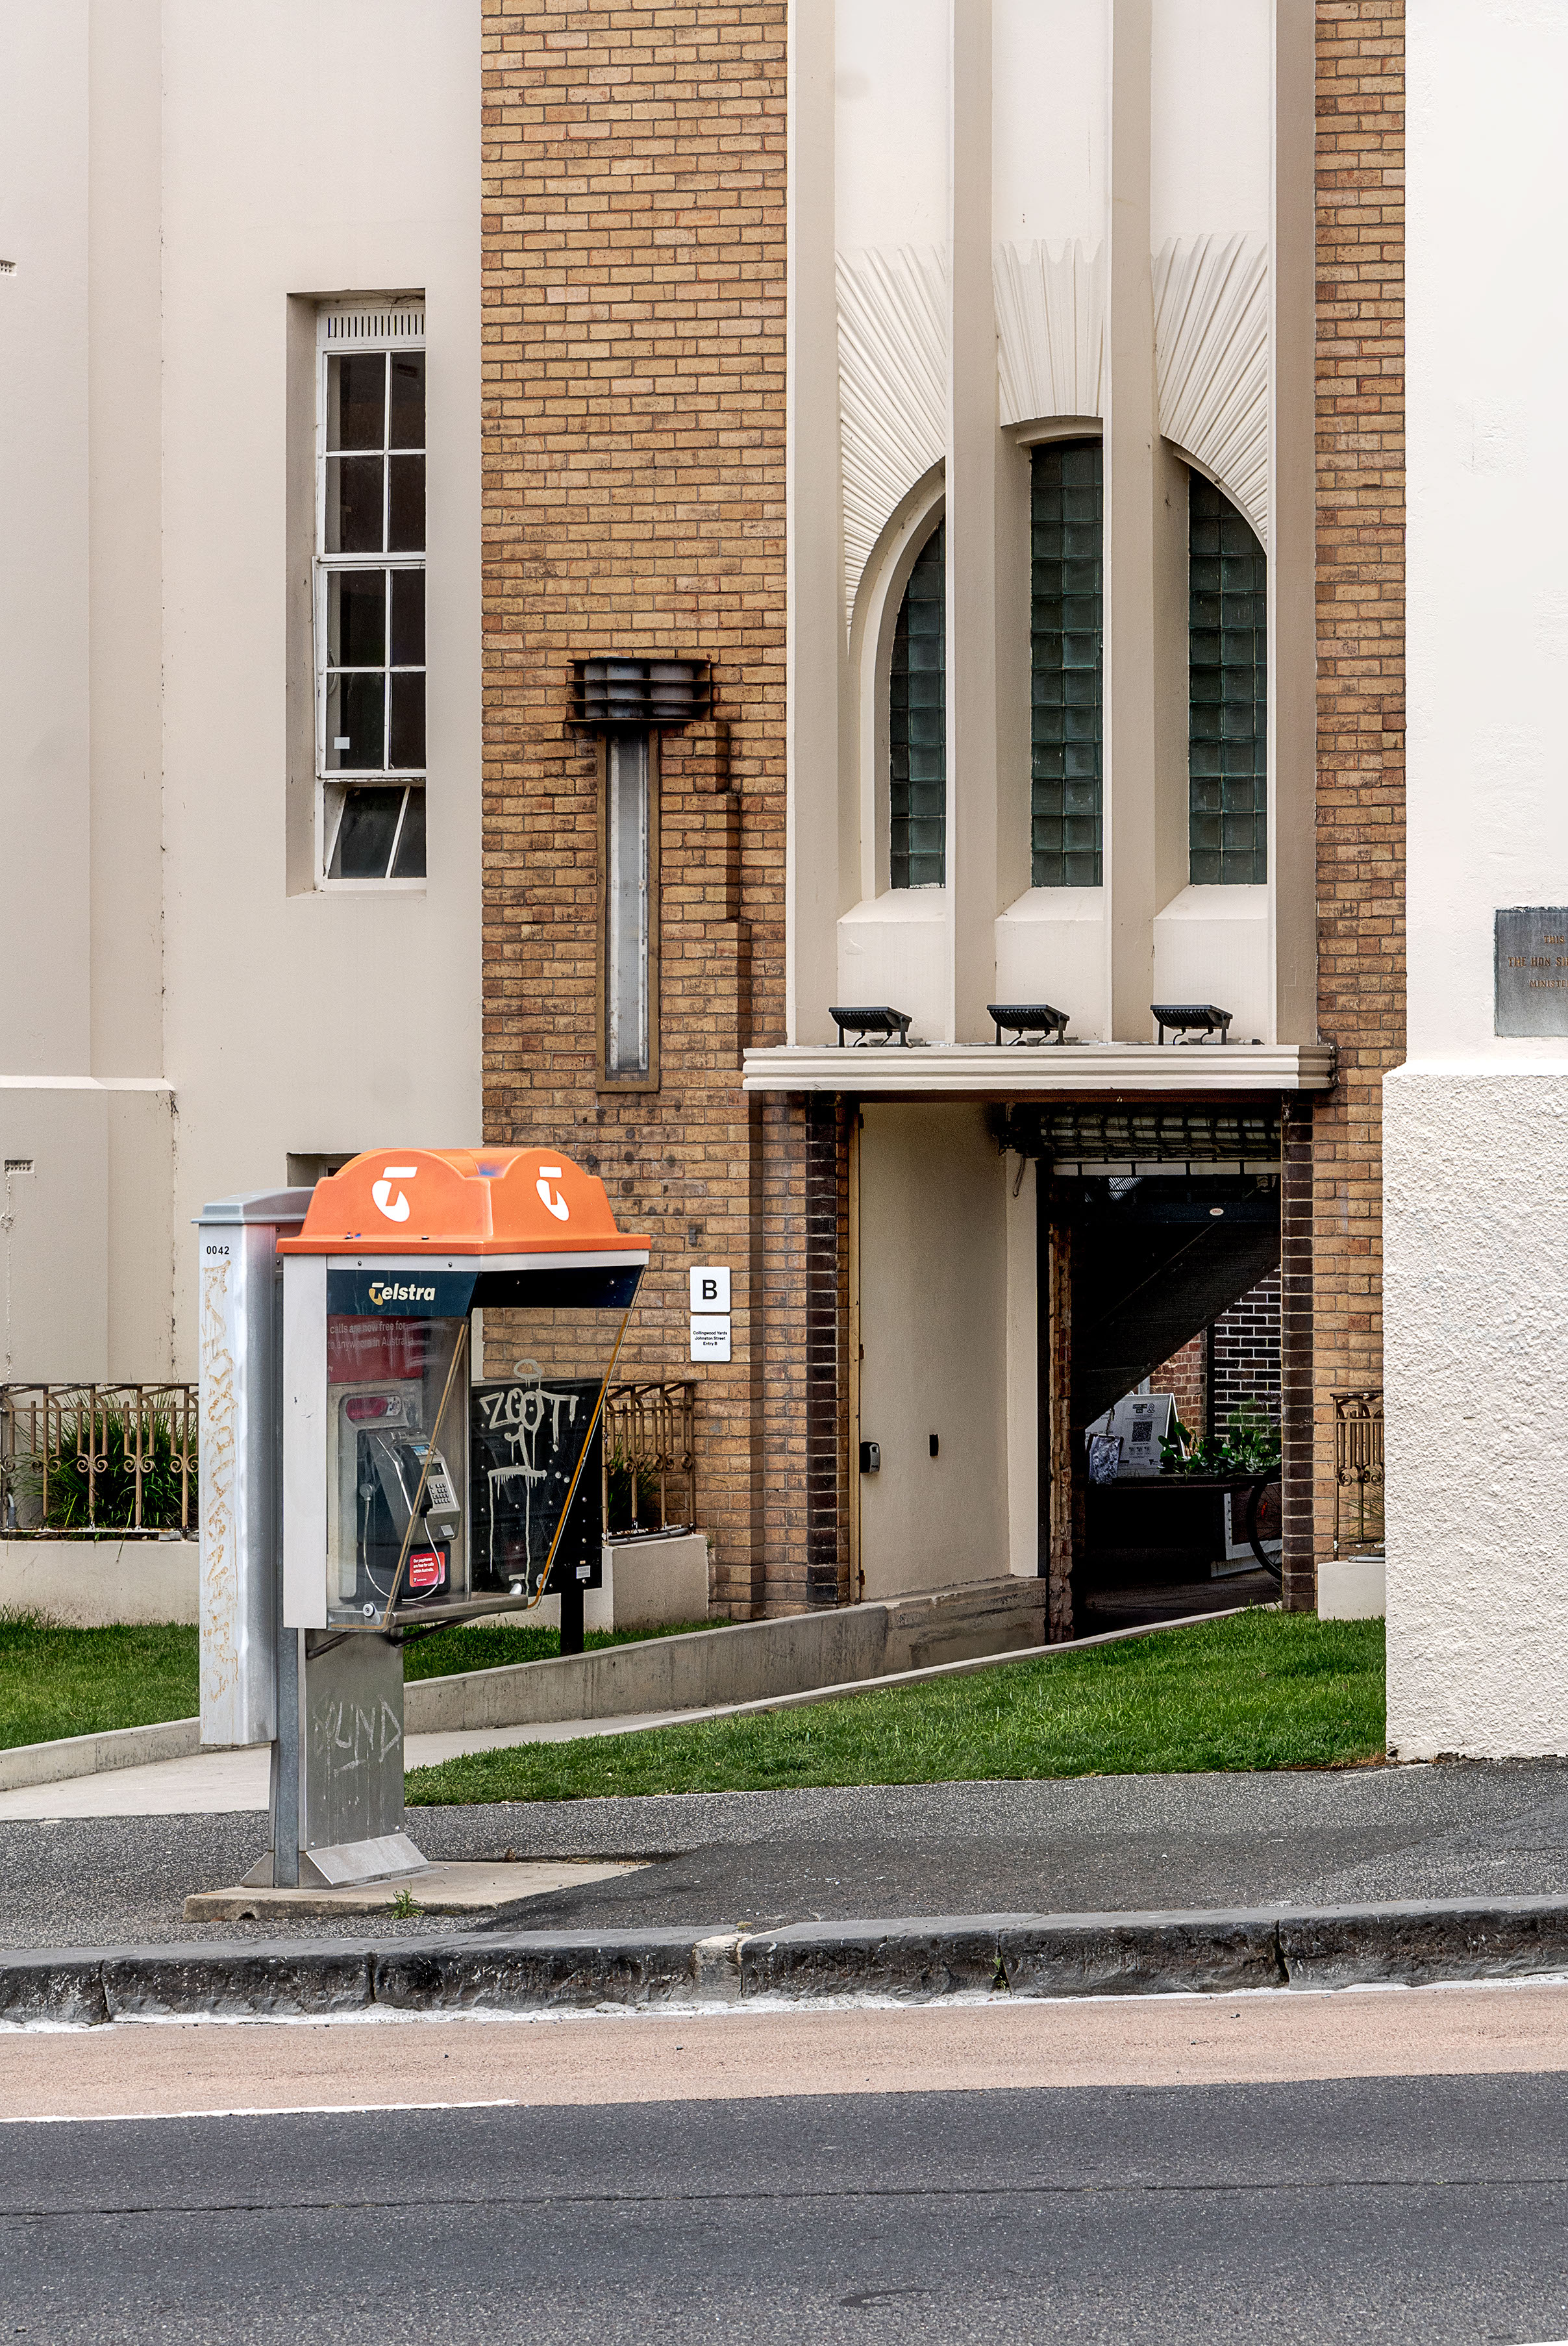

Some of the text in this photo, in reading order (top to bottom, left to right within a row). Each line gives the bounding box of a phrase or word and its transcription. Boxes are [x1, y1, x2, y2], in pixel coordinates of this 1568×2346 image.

[1508, 956, 1568, 967] THE HON SI
[206, 1245, 230, 1254] 0042
[369, 1282, 435, 1306] Telstra
[703, 1279, 717, 1299] B
[330, 1323, 348, 1334] calls
[379, 1321, 394, 1331] free
[395, 1320, 406, 1330] for
